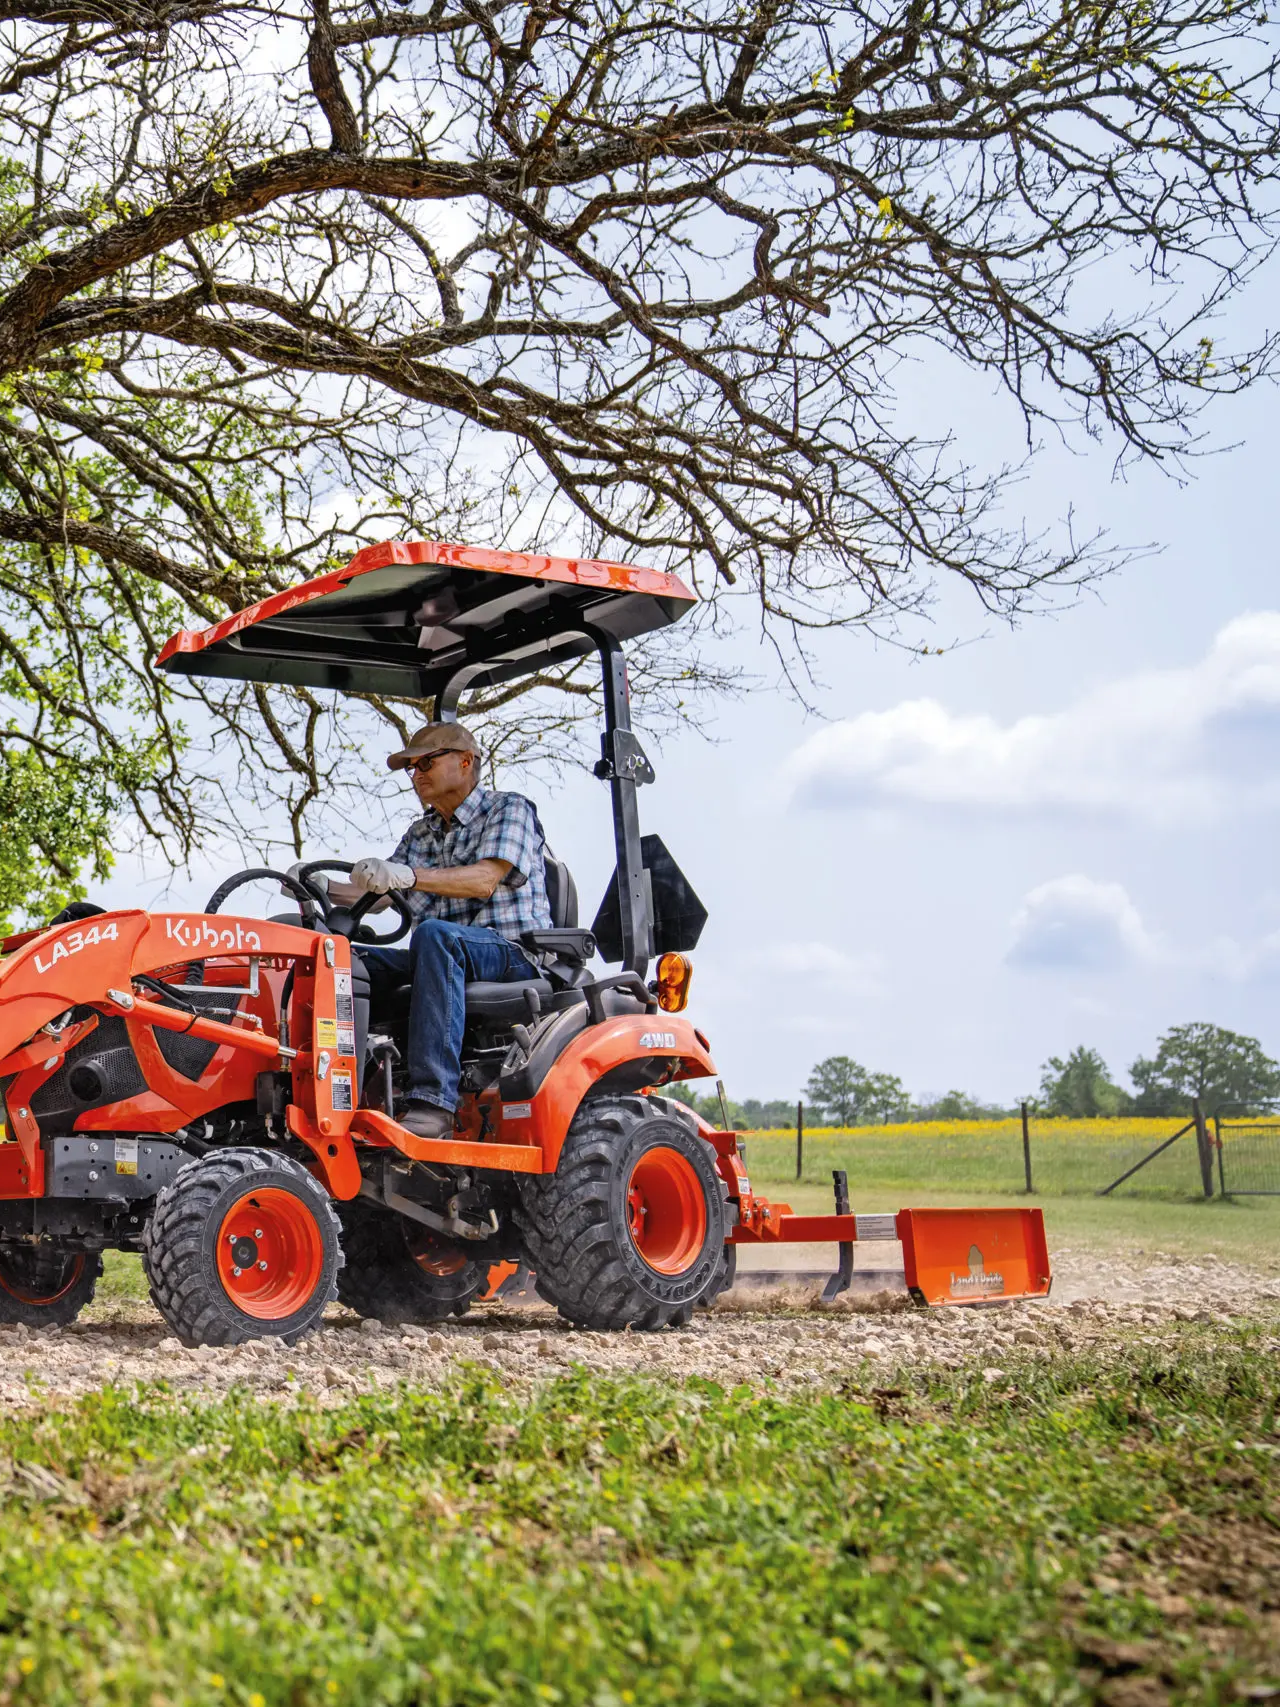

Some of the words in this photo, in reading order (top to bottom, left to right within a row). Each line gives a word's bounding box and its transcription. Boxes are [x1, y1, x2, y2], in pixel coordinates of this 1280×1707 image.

[33, 922, 119, 975] LA344
[165, 918, 261, 950] Kubota
[639, 1032, 676, 1049] 4WD
